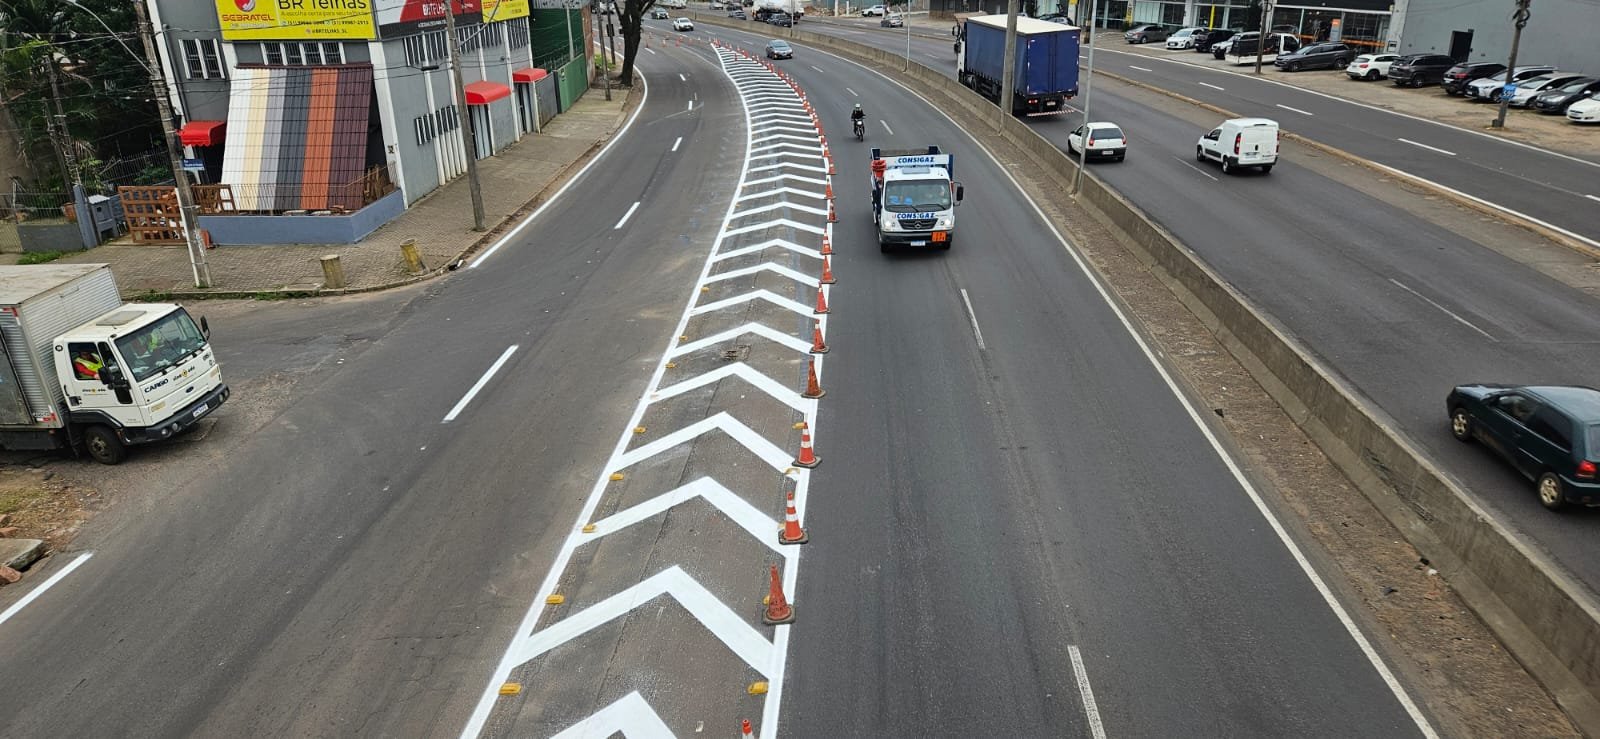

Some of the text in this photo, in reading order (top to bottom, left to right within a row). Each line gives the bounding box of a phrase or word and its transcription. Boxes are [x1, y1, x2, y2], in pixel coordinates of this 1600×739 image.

[222, 13, 275, 22] SEBRATEL
[898, 156, 935, 164] CONSIGAZ
[144, 378, 169, 394] CARGO
